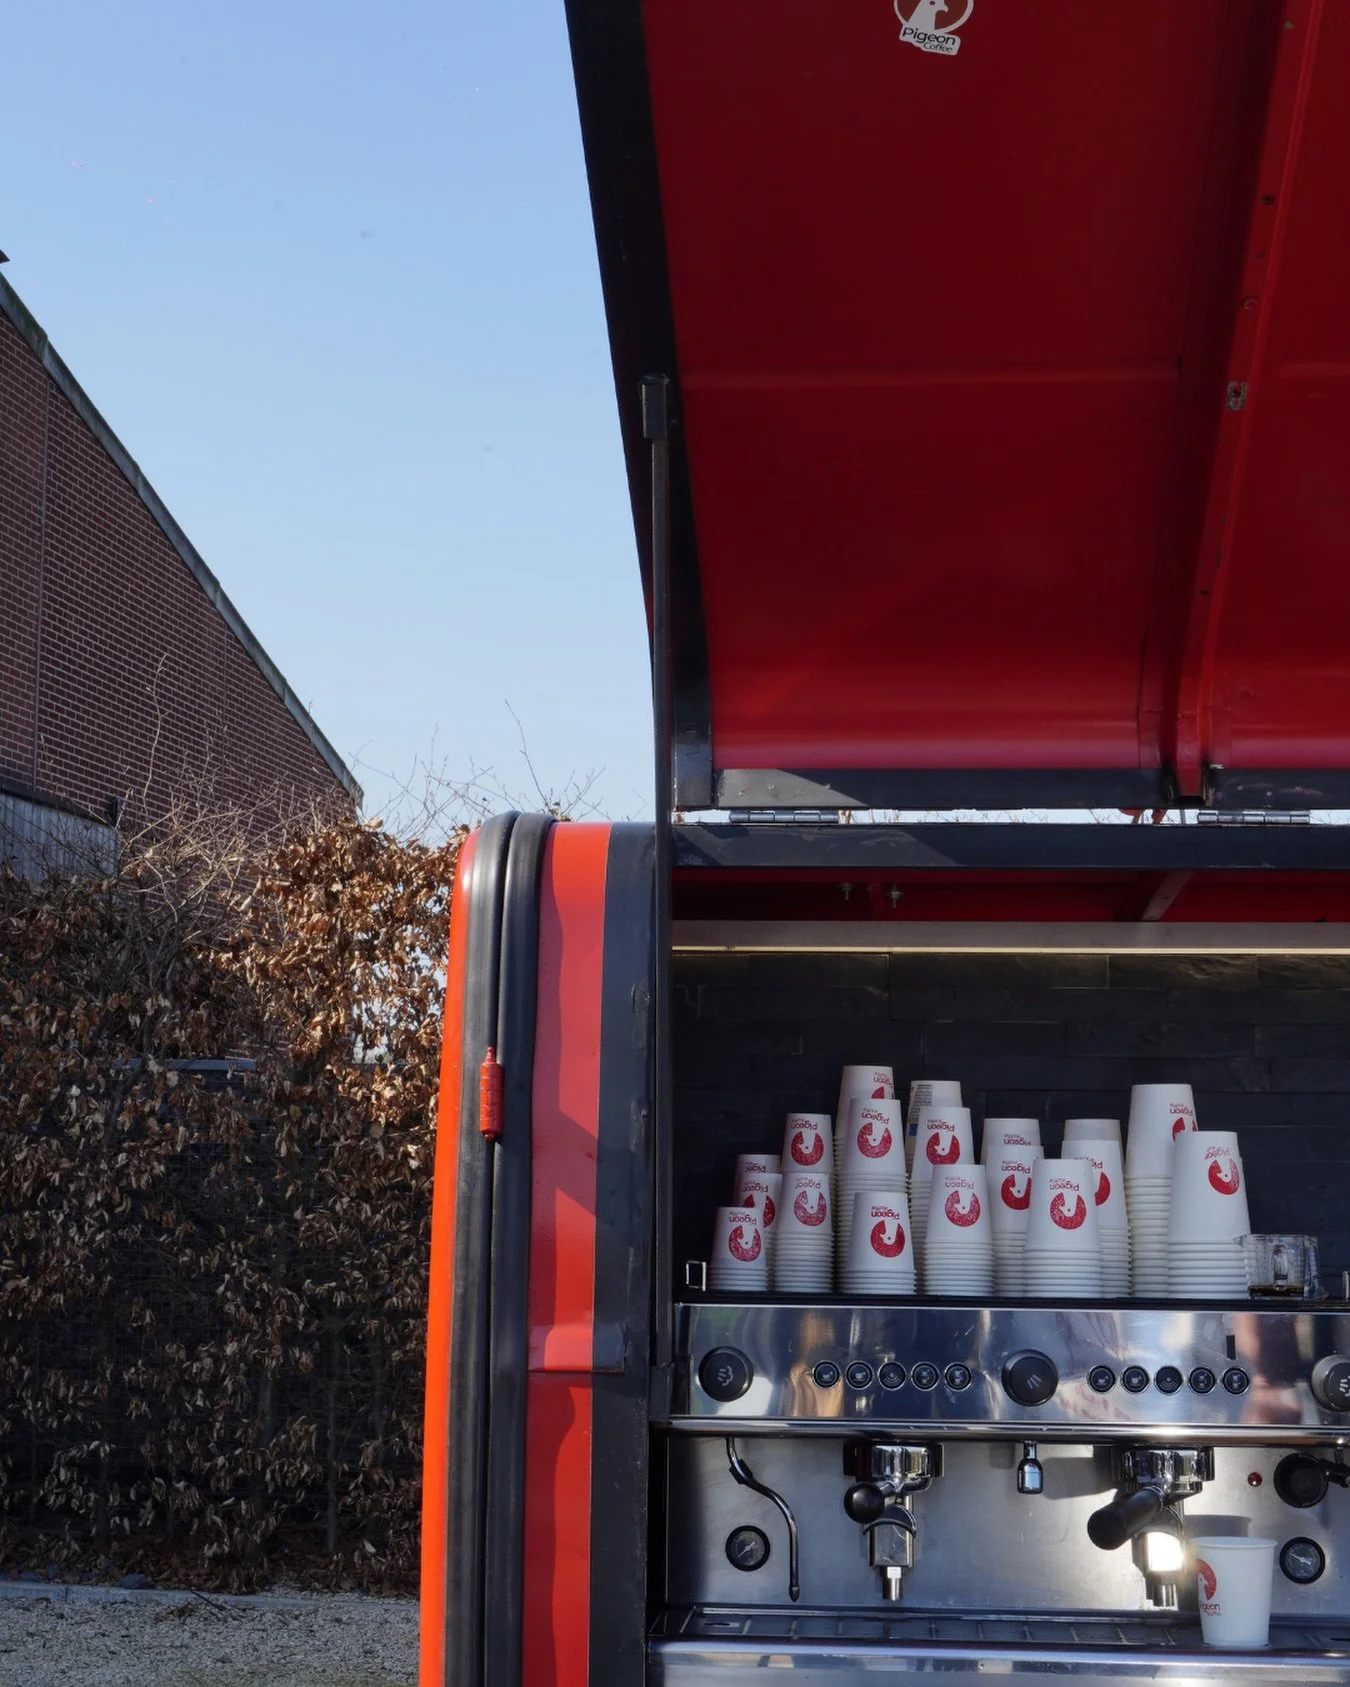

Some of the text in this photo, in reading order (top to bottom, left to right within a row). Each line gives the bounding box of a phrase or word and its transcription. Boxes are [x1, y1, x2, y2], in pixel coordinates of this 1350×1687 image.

[902, 27, 956, 45] Pigeon
[923, 42, 953, 52] Coffee
[1001, 1163, 1031, 1174] Pigeon
[871, 1208, 900, 1220] Pigeon
